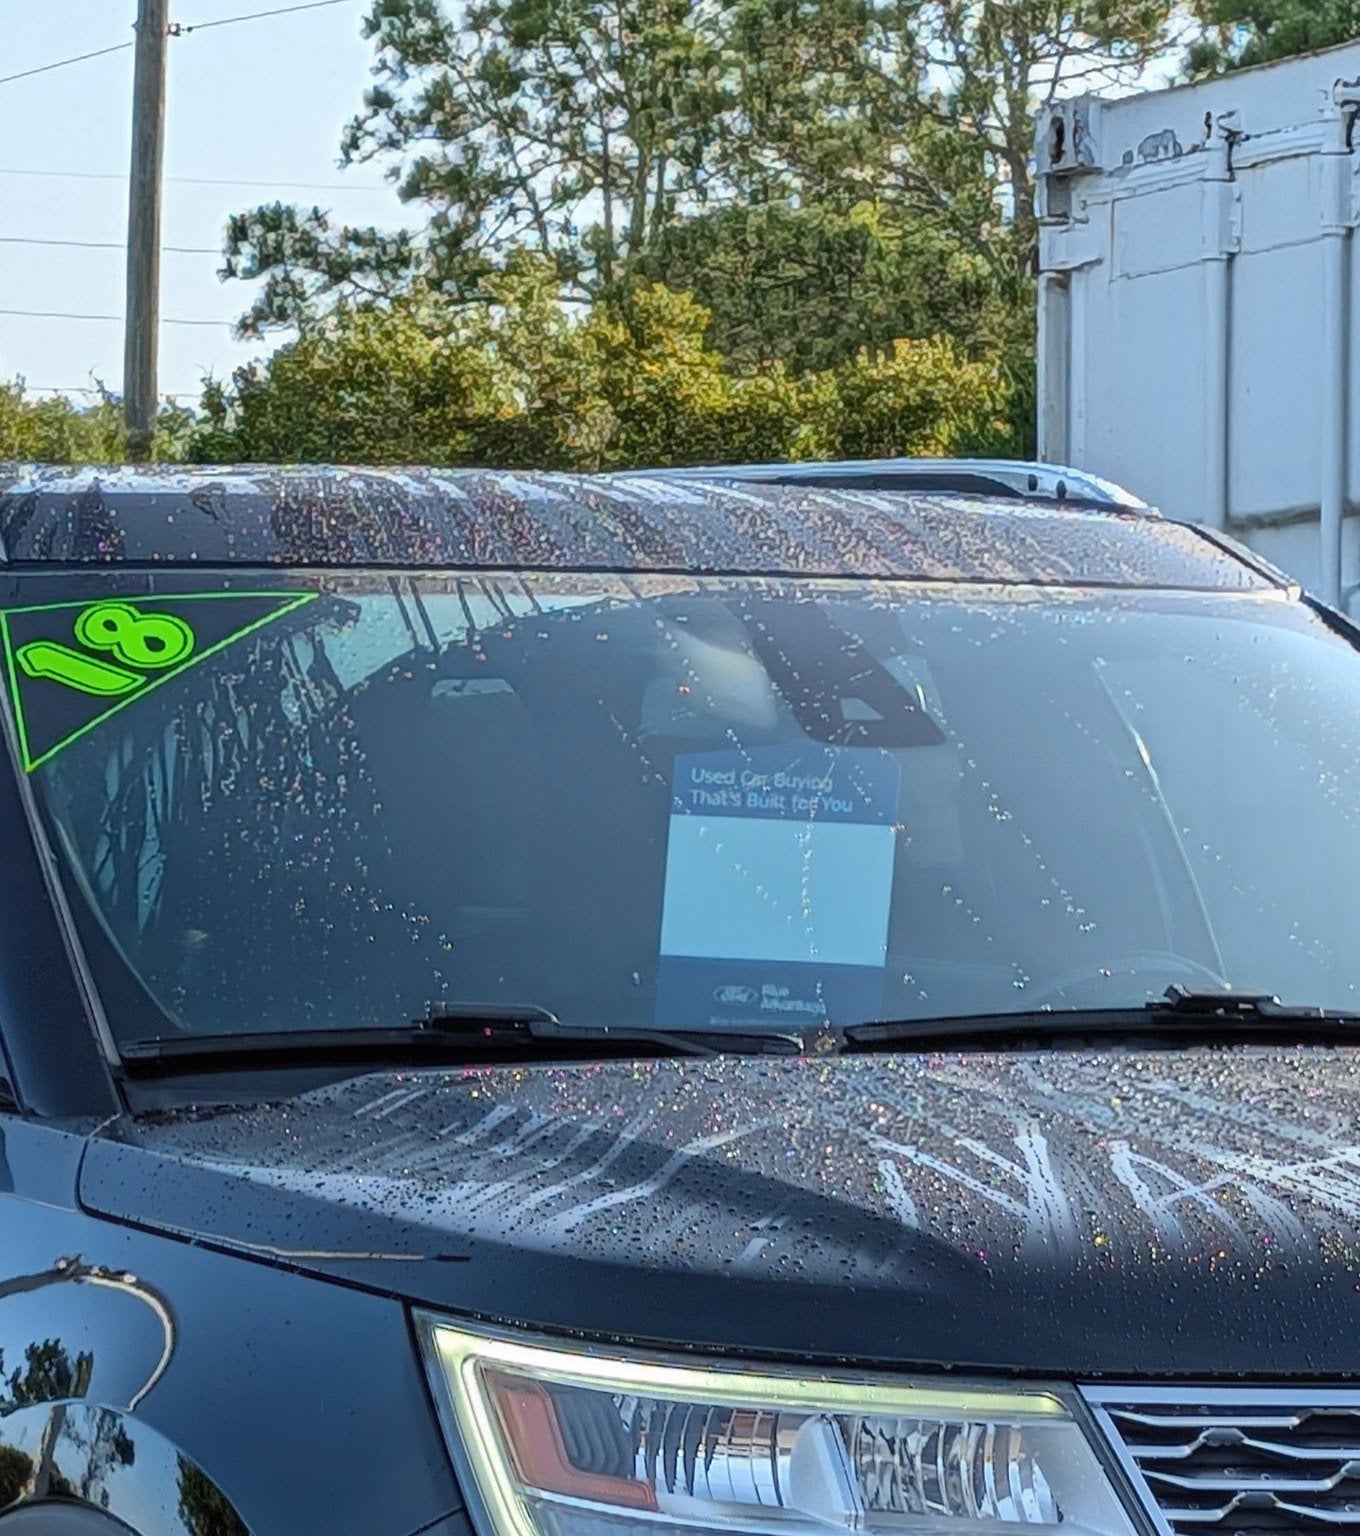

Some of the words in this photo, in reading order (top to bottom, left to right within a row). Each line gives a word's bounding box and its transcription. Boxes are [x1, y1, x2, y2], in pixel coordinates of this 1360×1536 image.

[16, 601, 195, 697] 18
[691, 766, 736, 785] Used
[774, 771, 833, 793] Buying
[690, 789, 742, 807] That's
[746, 792, 786, 809] Built
[822, 797, 853, 813] You
